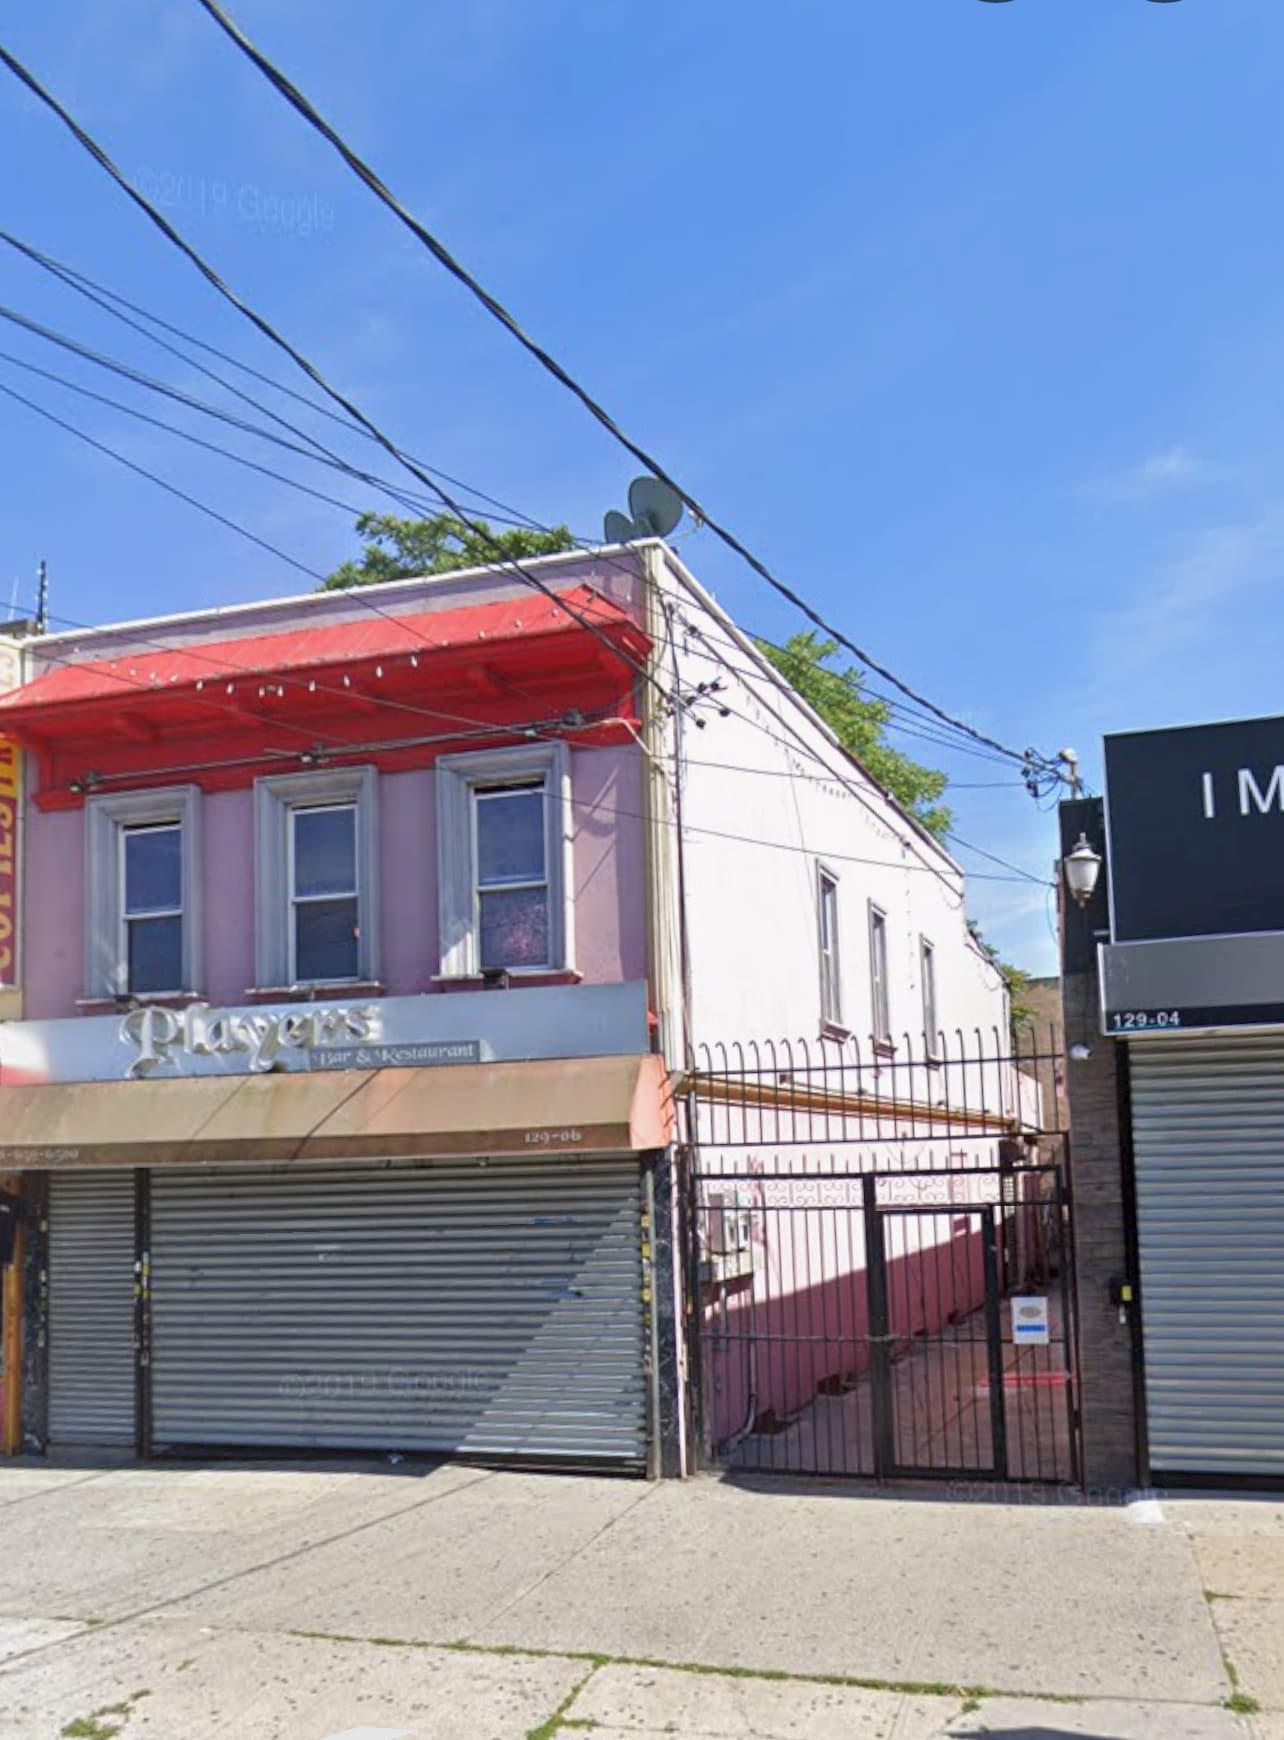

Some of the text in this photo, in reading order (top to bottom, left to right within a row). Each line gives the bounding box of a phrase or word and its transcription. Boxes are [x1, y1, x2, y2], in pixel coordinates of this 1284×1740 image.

[1113, 1011, 1180, 1029] 129-04
[119, 1003, 383, 1078] Players
[316, 1044, 474, 1066] Bar & Restaurant
[524, 1128, 582, 1144] 129-06
